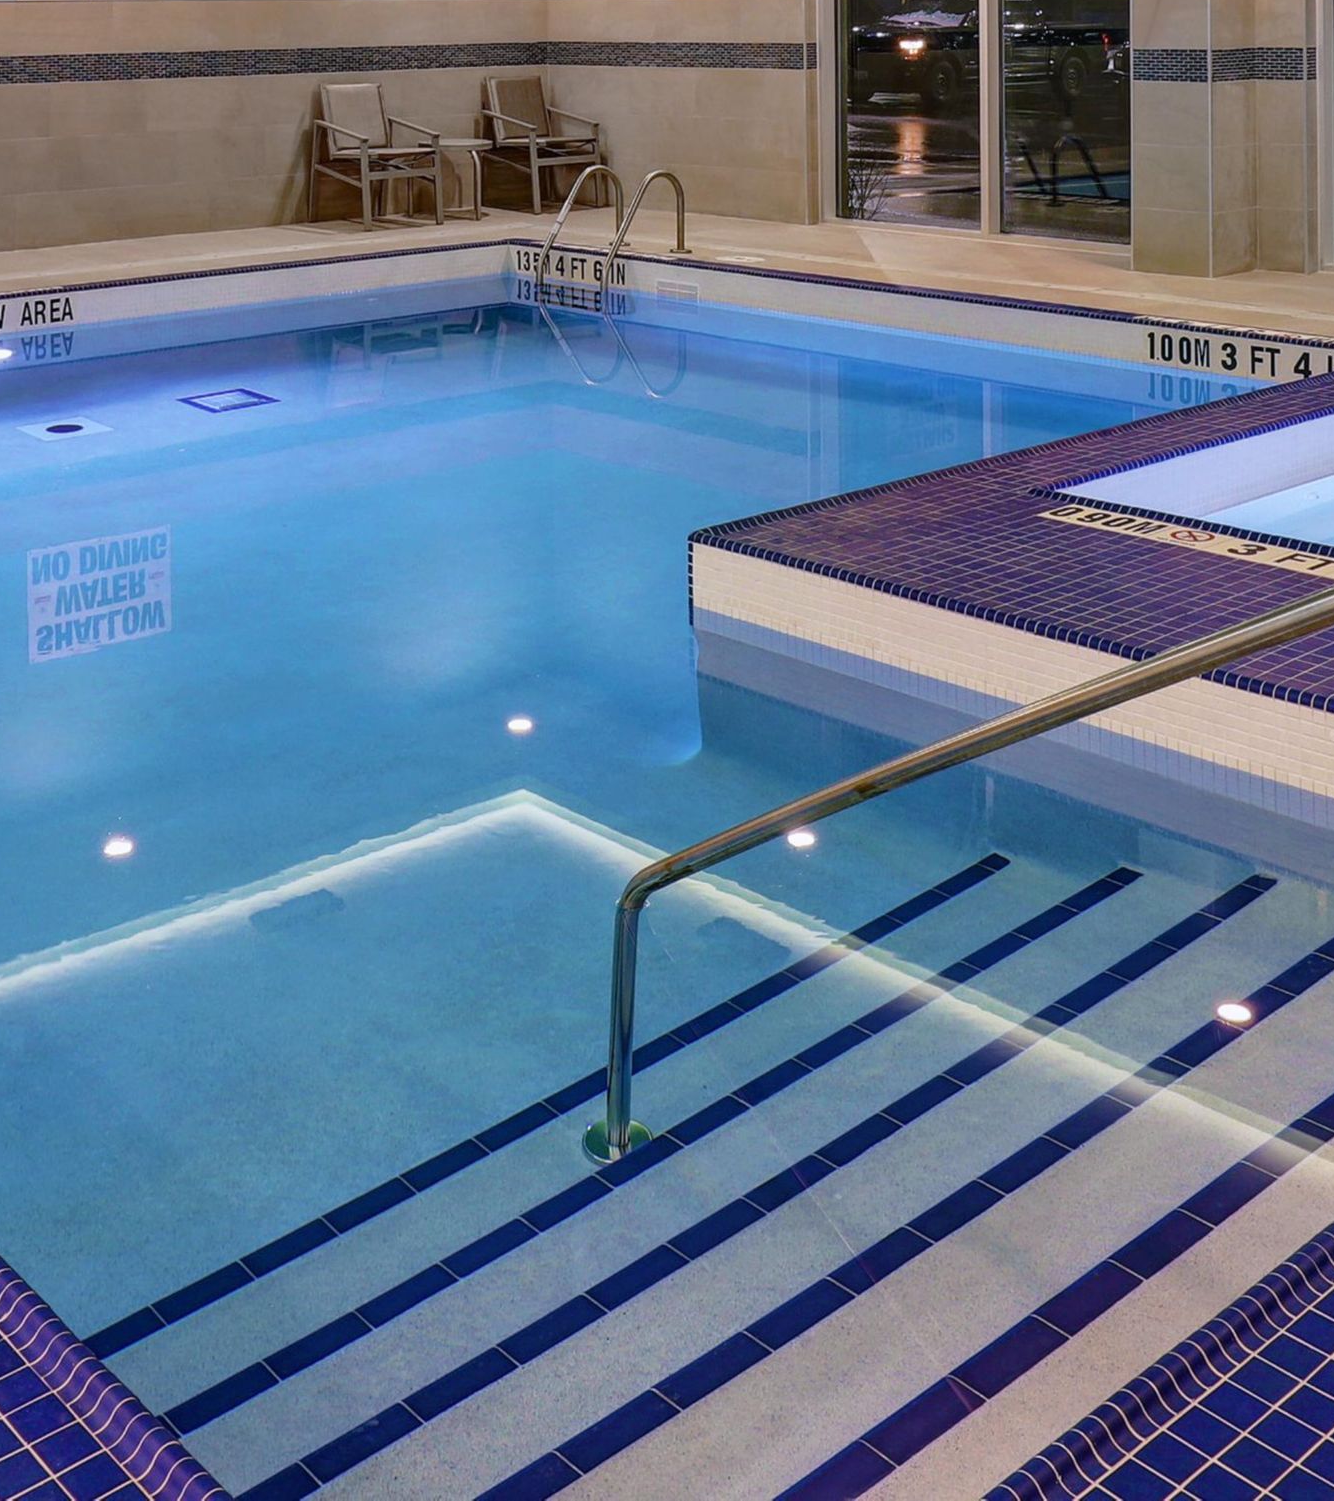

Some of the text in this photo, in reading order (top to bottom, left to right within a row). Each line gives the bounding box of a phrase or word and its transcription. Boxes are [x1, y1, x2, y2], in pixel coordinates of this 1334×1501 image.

[555, 255, 565, 277] 4
[571, 257, 587, 281] FT
[593, 260, 603, 279] 6
[610, 262, 626, 286] IN
[20, 297, 74, 327] AREA
[1147, 332, 1210, 369] 1.00M
[1221, 343, 1237, 371] 3
[1250, 345, 1281, 377] FT
[1293, 352, 1312, 379] 4
[1227, 543, 1267, 556] 3
